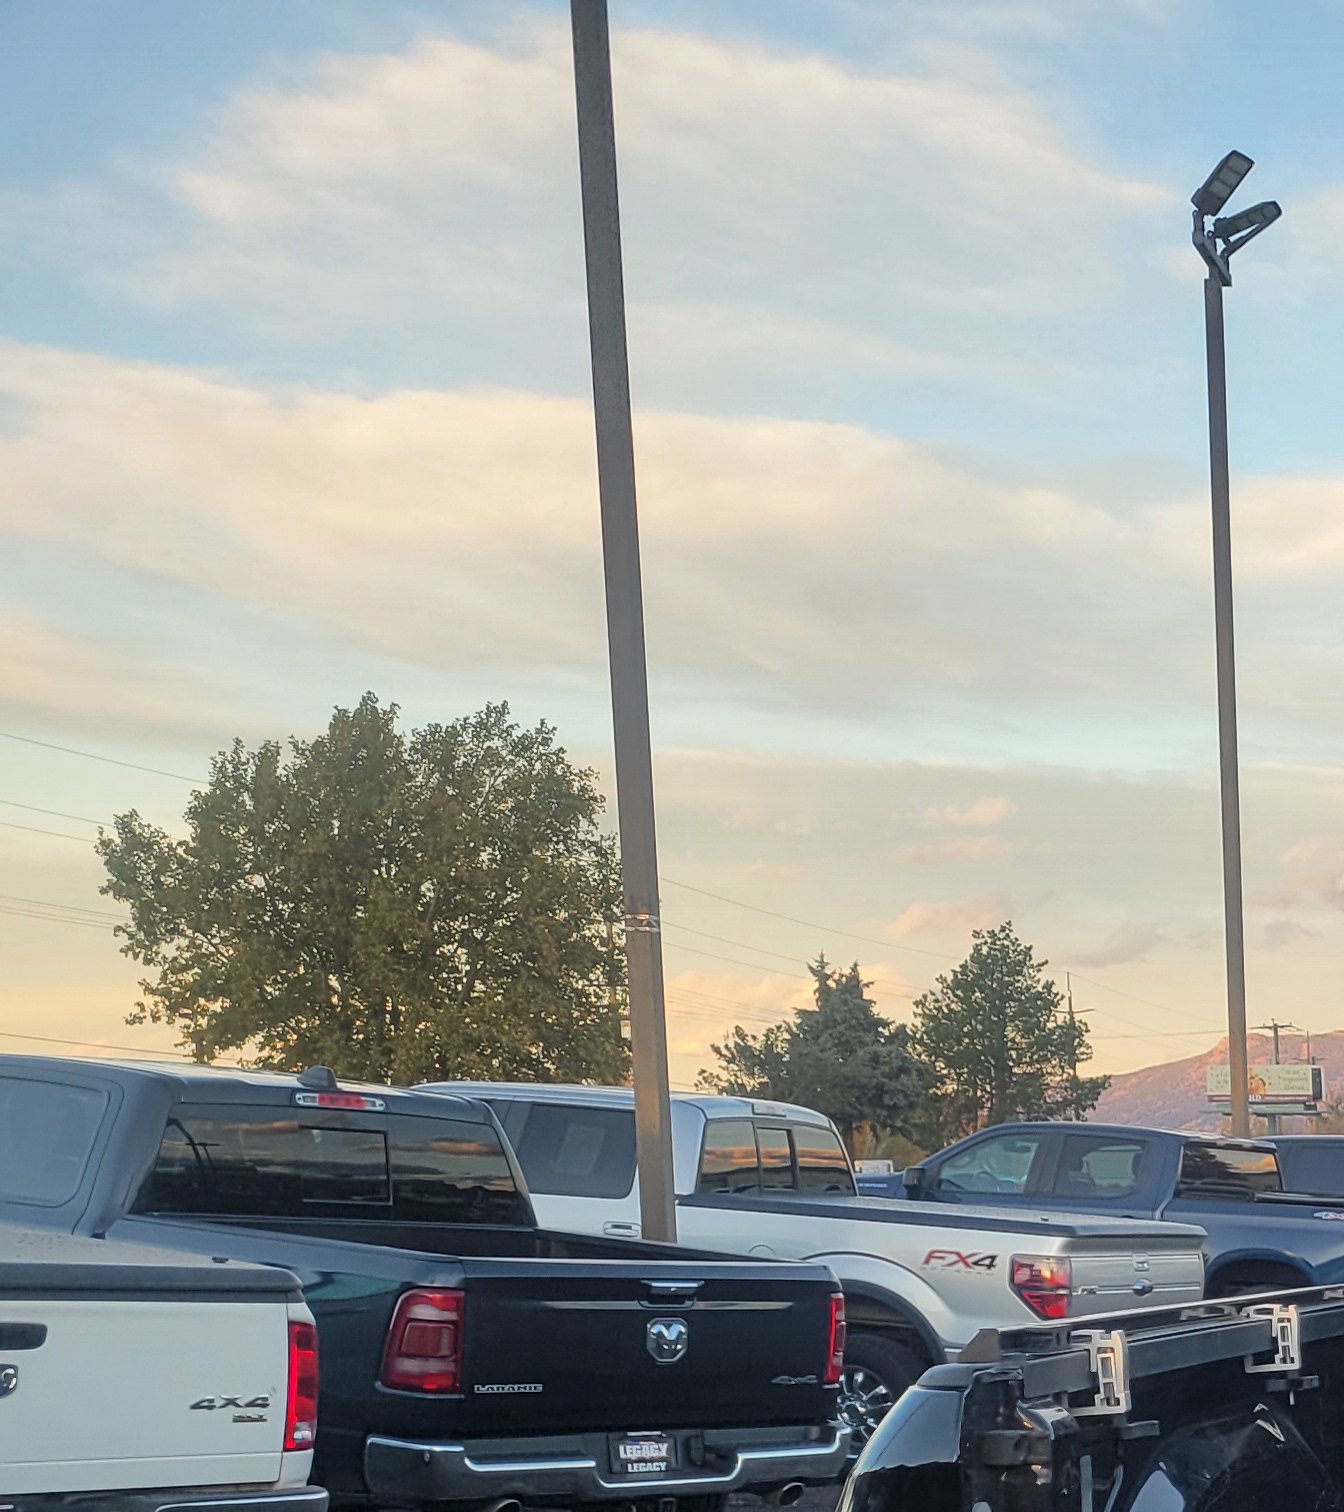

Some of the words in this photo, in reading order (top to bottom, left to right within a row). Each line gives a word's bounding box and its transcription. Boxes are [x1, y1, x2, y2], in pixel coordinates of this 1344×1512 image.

[921, 1249, 998, 1270] FX4
[474, 1383, 543, 1394] LARAMIE
[619, 1442, 669, 1460] LEGACY
[627, 1461, 667, 1473] LEGACY
